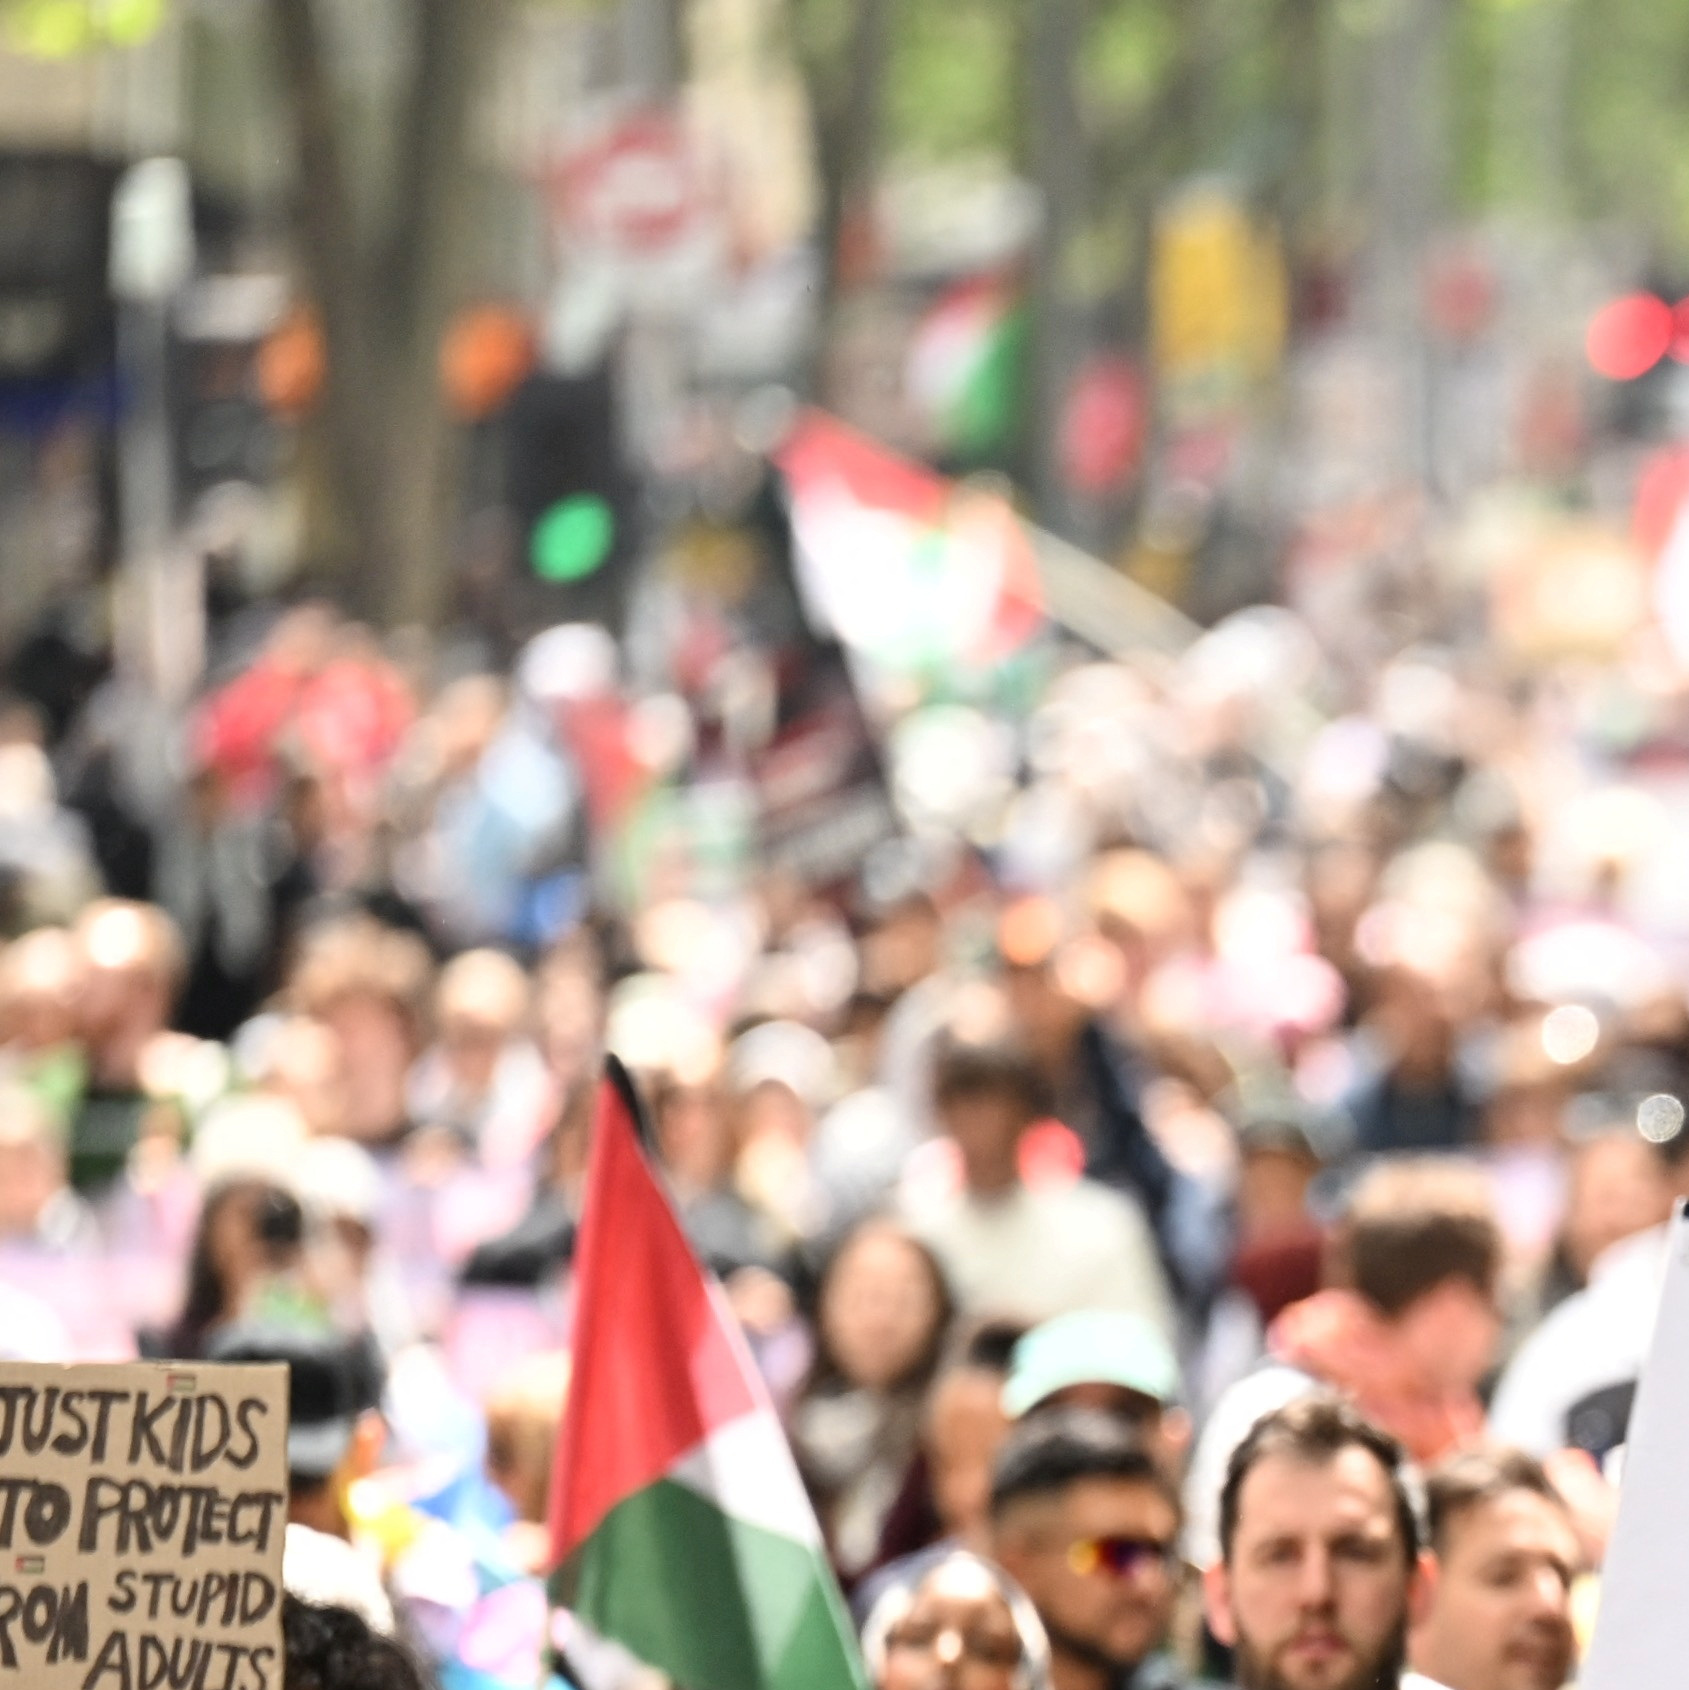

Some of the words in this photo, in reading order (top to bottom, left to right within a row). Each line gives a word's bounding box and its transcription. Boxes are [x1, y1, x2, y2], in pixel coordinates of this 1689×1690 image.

[0, 1386, 129, 1463] JUST
[128, 1393, 269, 1473] KIDS
[0, 1477, 71, 1550] TO
[78, 1476, 282, 1557] PROTECT
[0, 1579, 90, 1669] ROM
[107, 1569, 276, 1627] STUPID
